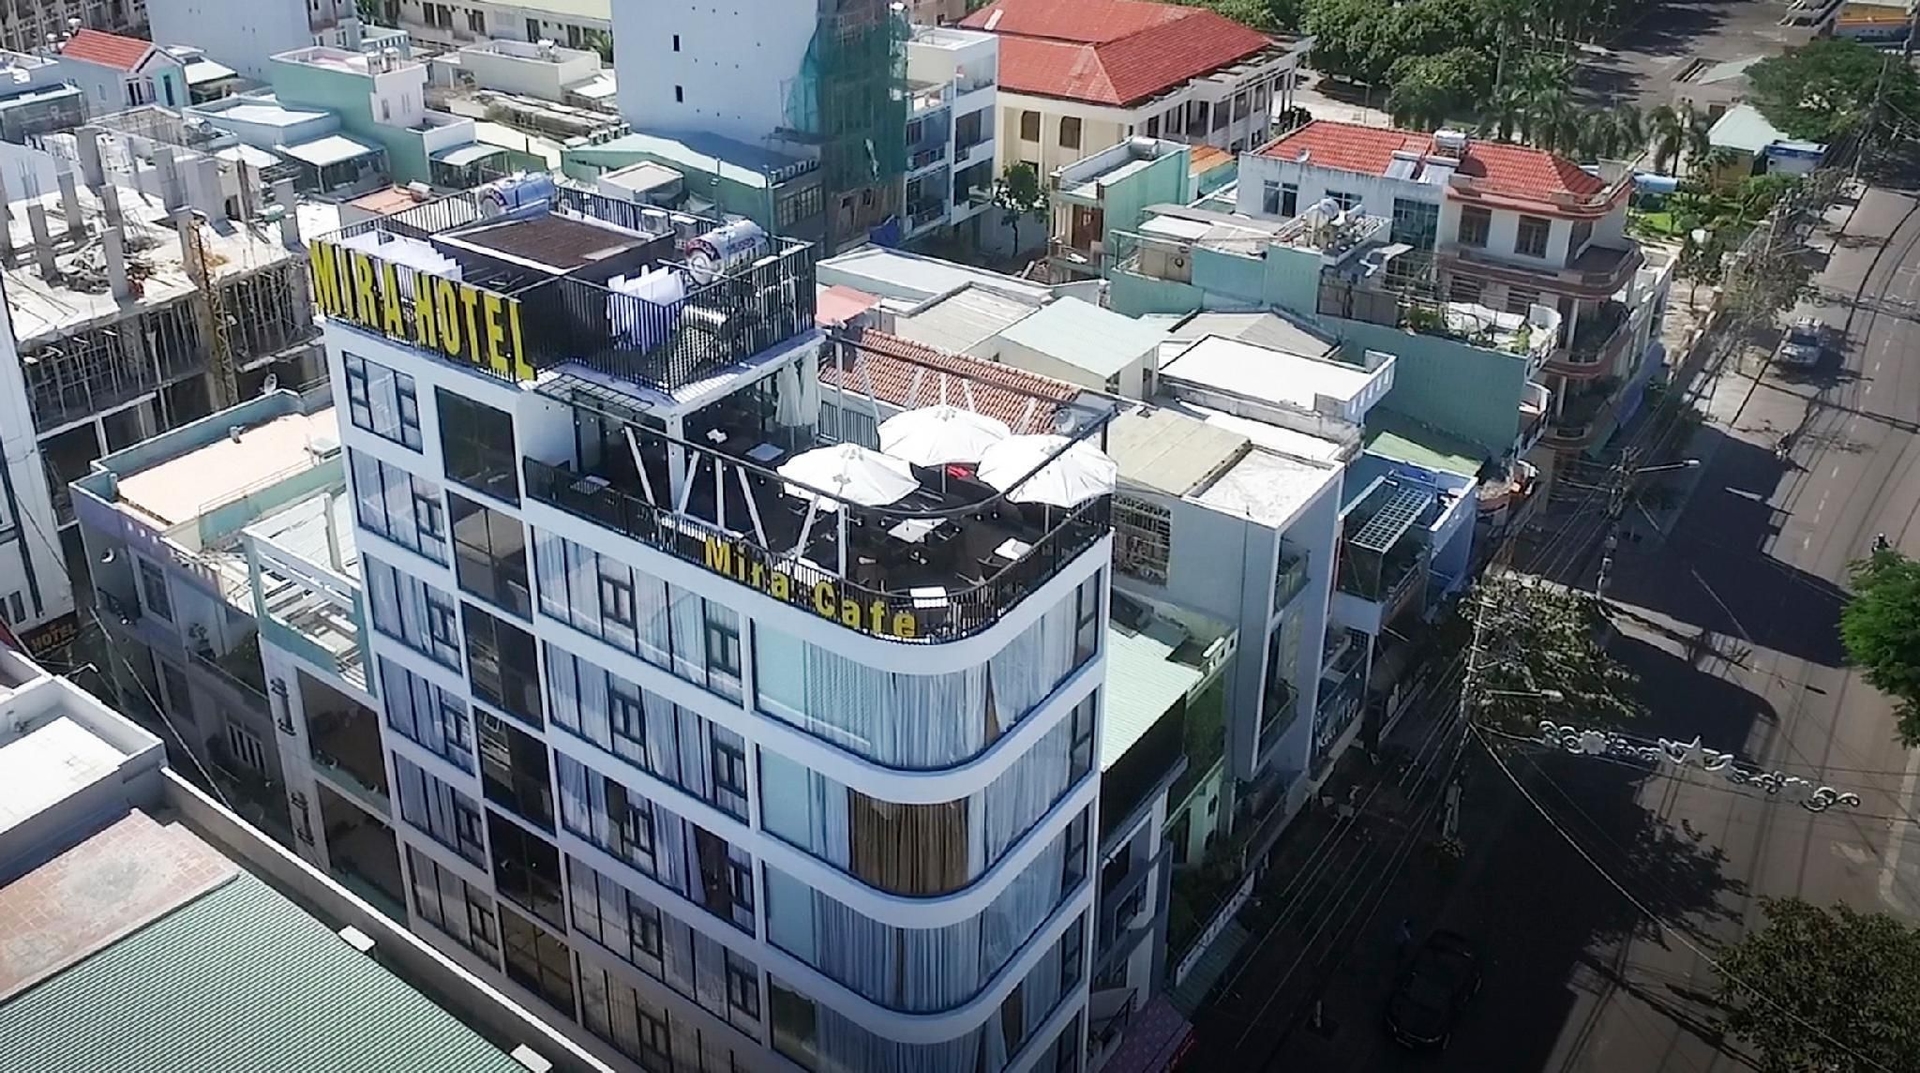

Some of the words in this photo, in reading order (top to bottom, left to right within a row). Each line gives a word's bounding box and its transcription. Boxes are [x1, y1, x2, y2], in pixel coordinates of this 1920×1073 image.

[310, 239, 405, 339] MIRA
[413, 270, 537, 382] HOTEL
[30, 623, 78, 652] HOTEL
[705, 535, 790, 601] Mira
[814, 579, 917, 638] Cafe
